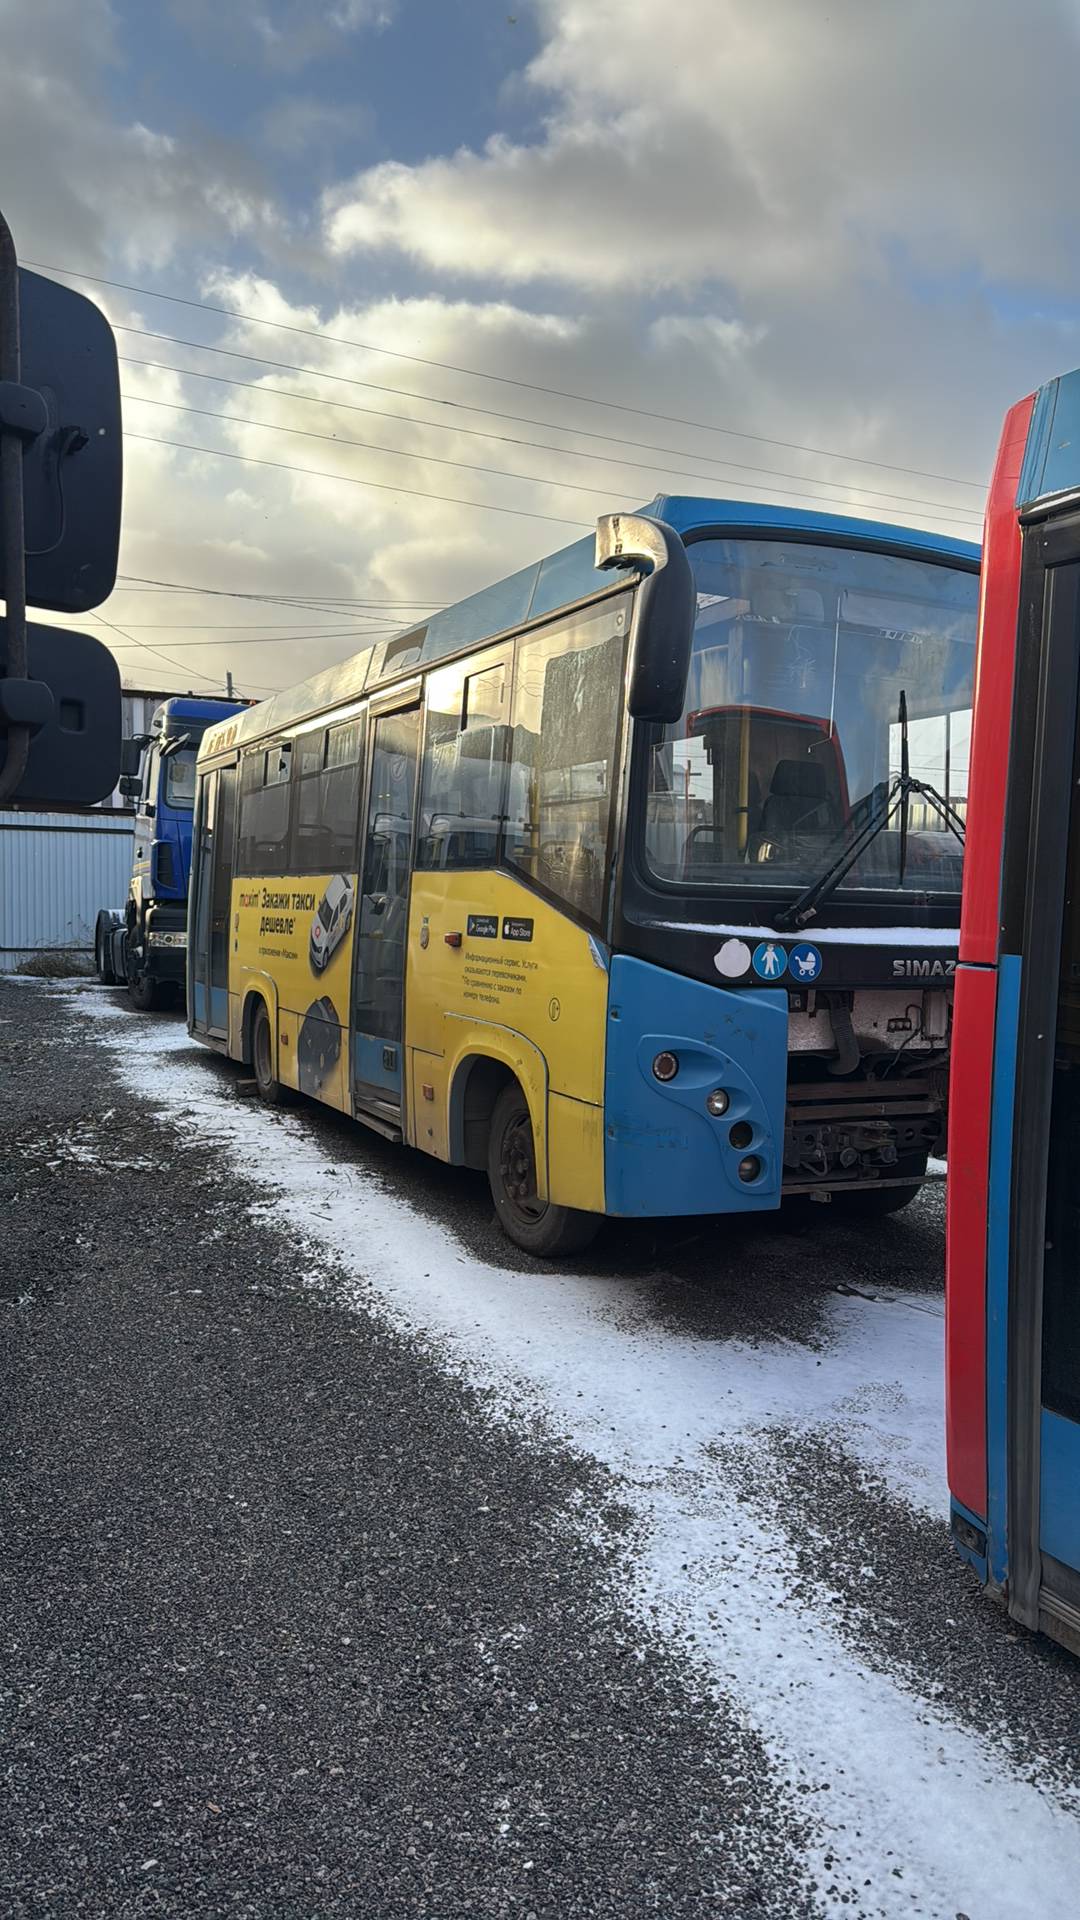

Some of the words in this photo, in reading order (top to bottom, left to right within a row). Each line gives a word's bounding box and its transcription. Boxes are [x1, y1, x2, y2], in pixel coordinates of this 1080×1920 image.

[261, 887, 290, 910] Закажи
[292, 893, 316, 911] такси
[510, 927, 519, 937] App
[519, 927, 531, 938] Store
[893, 960, 956, 976] SIMAZ
